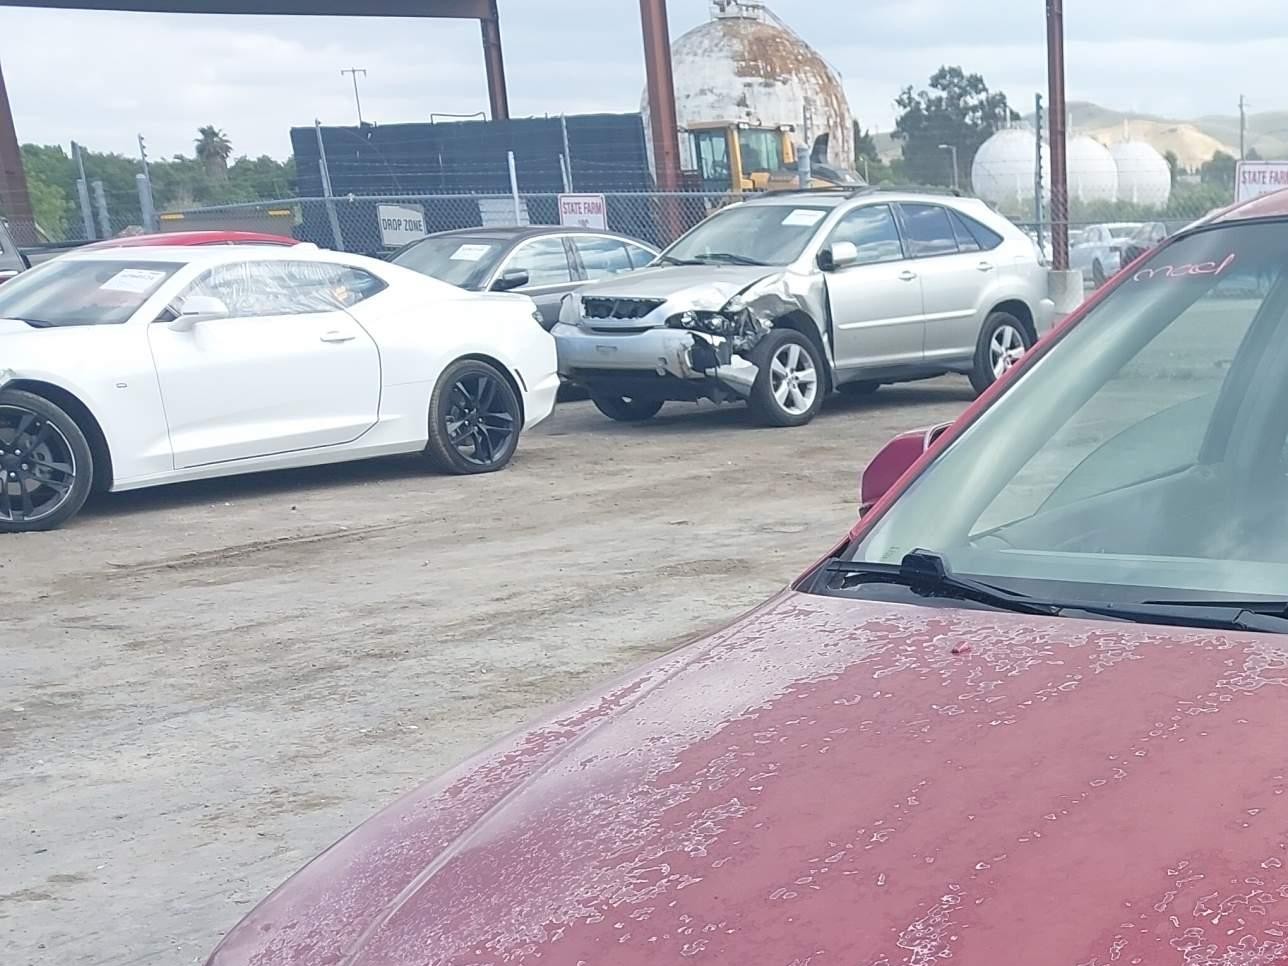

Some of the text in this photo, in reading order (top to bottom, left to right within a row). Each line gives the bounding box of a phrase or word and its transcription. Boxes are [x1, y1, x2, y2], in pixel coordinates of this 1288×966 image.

[1241, 170, 1267, 185] STATE
[562, 201, 602, 215] STATE FARM
[381, 218, 424, 232] DROP ZONE
